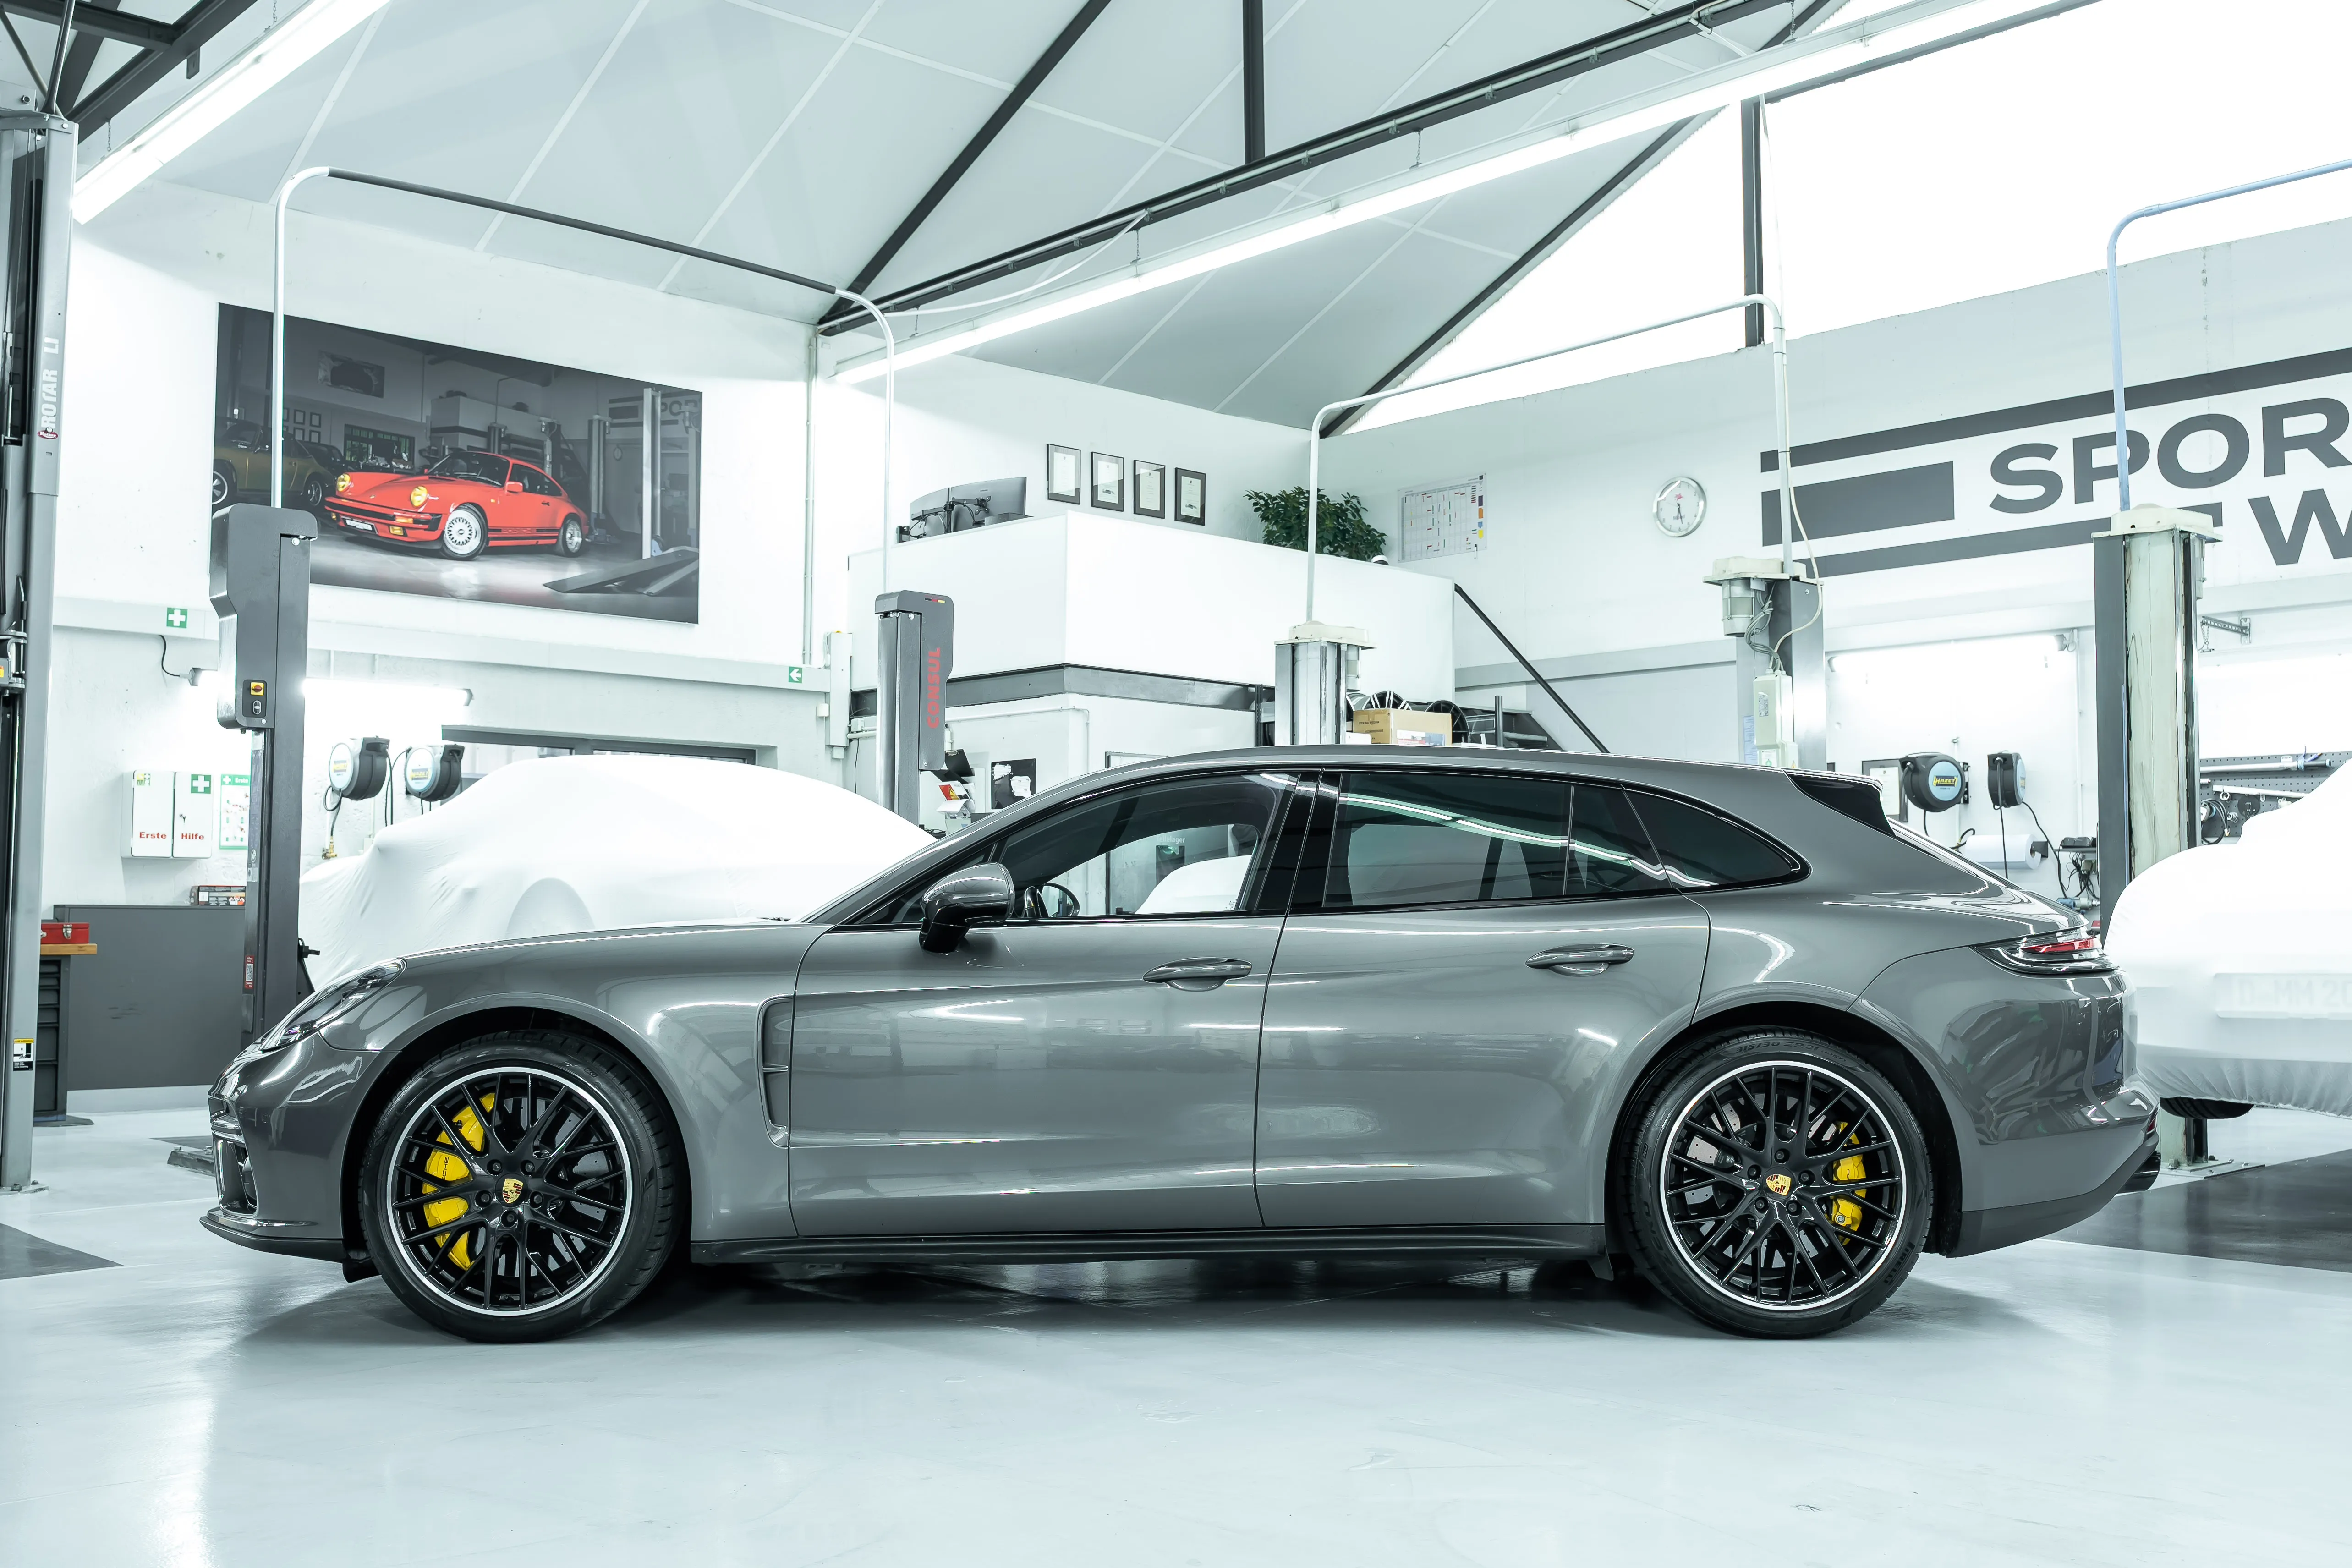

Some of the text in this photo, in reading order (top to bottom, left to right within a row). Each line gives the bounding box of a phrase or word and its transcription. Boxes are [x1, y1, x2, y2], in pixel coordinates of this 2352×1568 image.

[1989, 397, 2352, 514] SPOR
[2247, 488, 2352, 566] W
[927, 647, 941, 729] CONSUL
